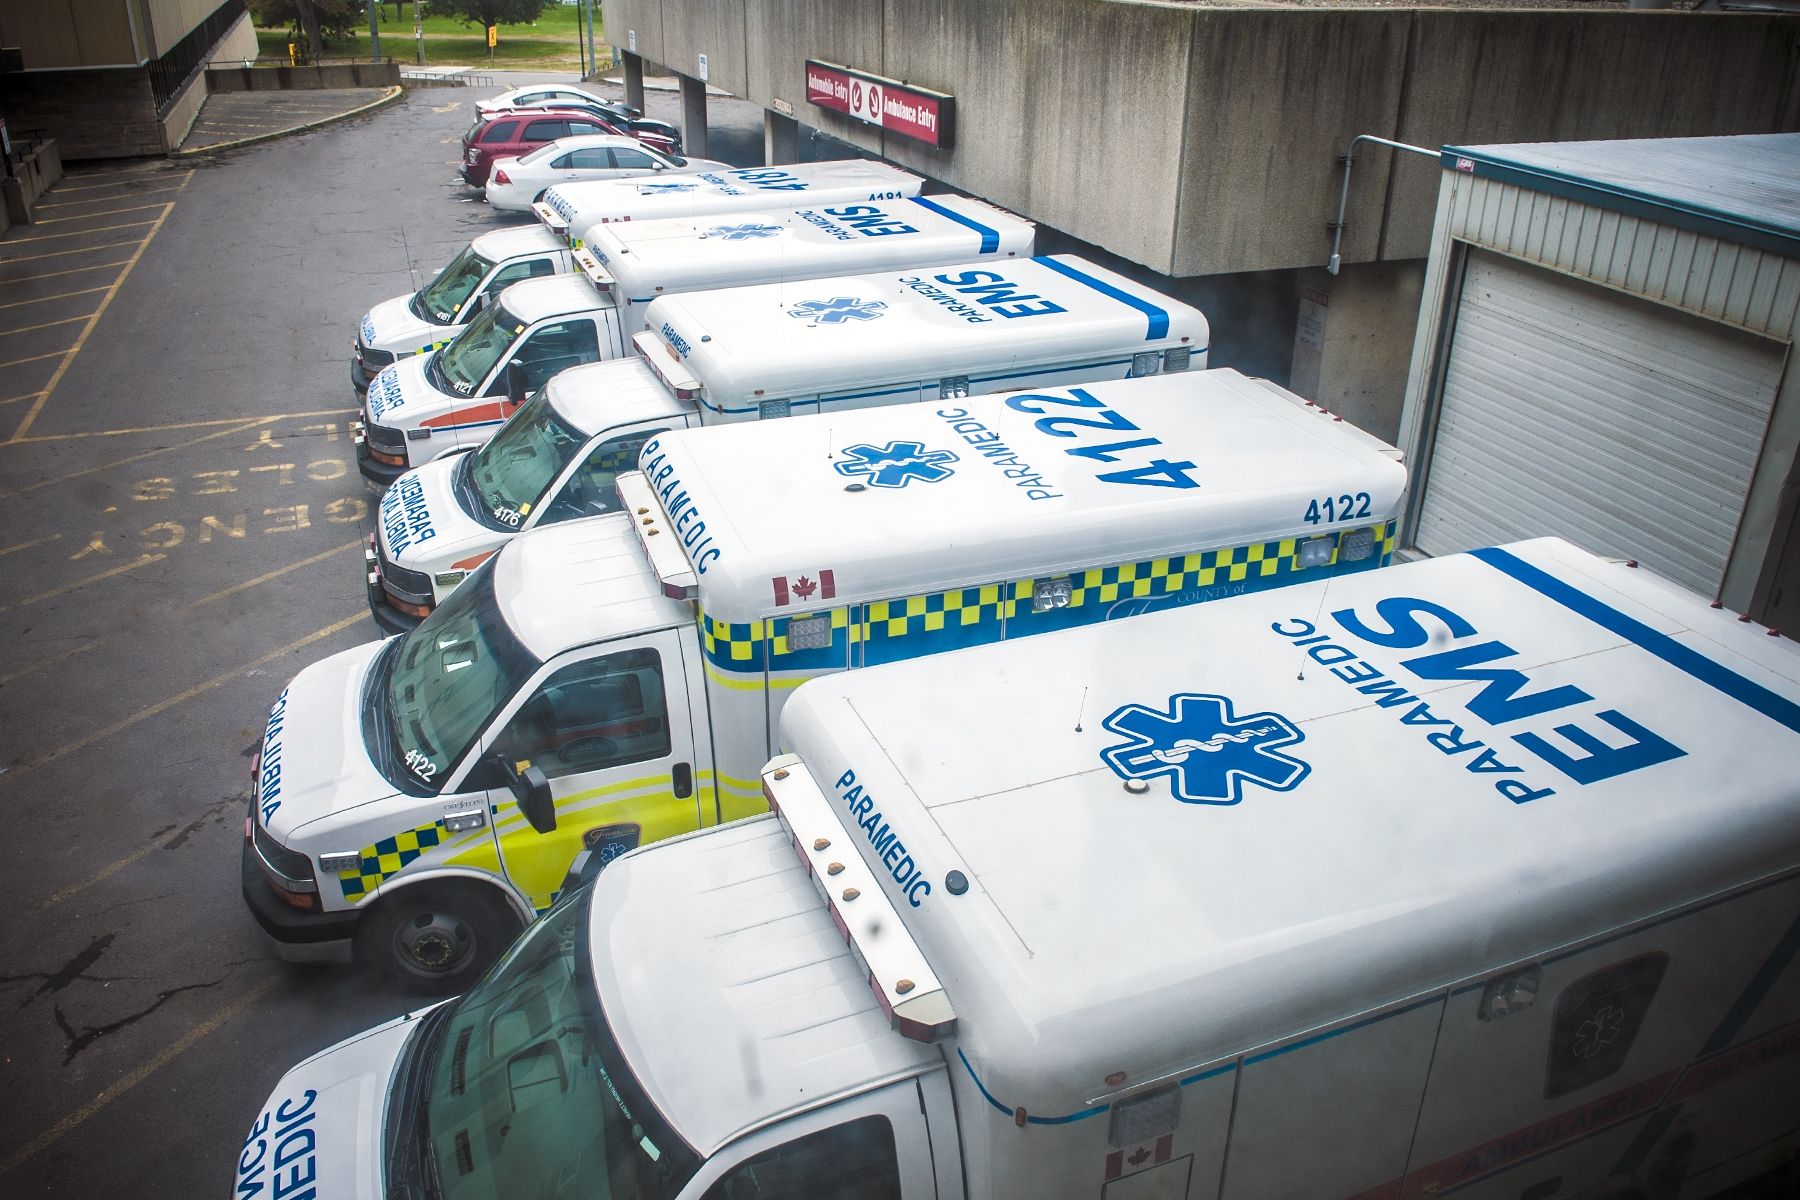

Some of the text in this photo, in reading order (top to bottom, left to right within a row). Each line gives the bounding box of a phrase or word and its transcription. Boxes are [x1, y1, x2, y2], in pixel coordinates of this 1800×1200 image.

[808, 72, 849, 103] Automobile Entry
[883, 95, 936, 132] Ambulance Entry
[727, 167, 810, 191] 4181
[824, 205, 920, 237] EMS
[899, 276, 993, 324] PARAMEDIC
[933, 270, 1069, 319] EMS
[661, 322, 691, 359] PARAMEDIC
[453, 380, 474, 395] 4121
[936, 407, 1064, 501] PARAMEDIC
[1004, 388, 1201, 490] 4122
[493, 505, 521, 526] 4176
[640, 439, 721, 575] PARAMEDIC
[1303, 491, 1372, 525] 4122
[1177, 582, 1247, 603] COUNTY of
[1330, 596, 1690, 786] EMS
[1271, 618, 1557, 805] PARAMEDIC
[404, 749, 437, 783] 4122
[835, 768, 931, 908] PARAMEDIC
